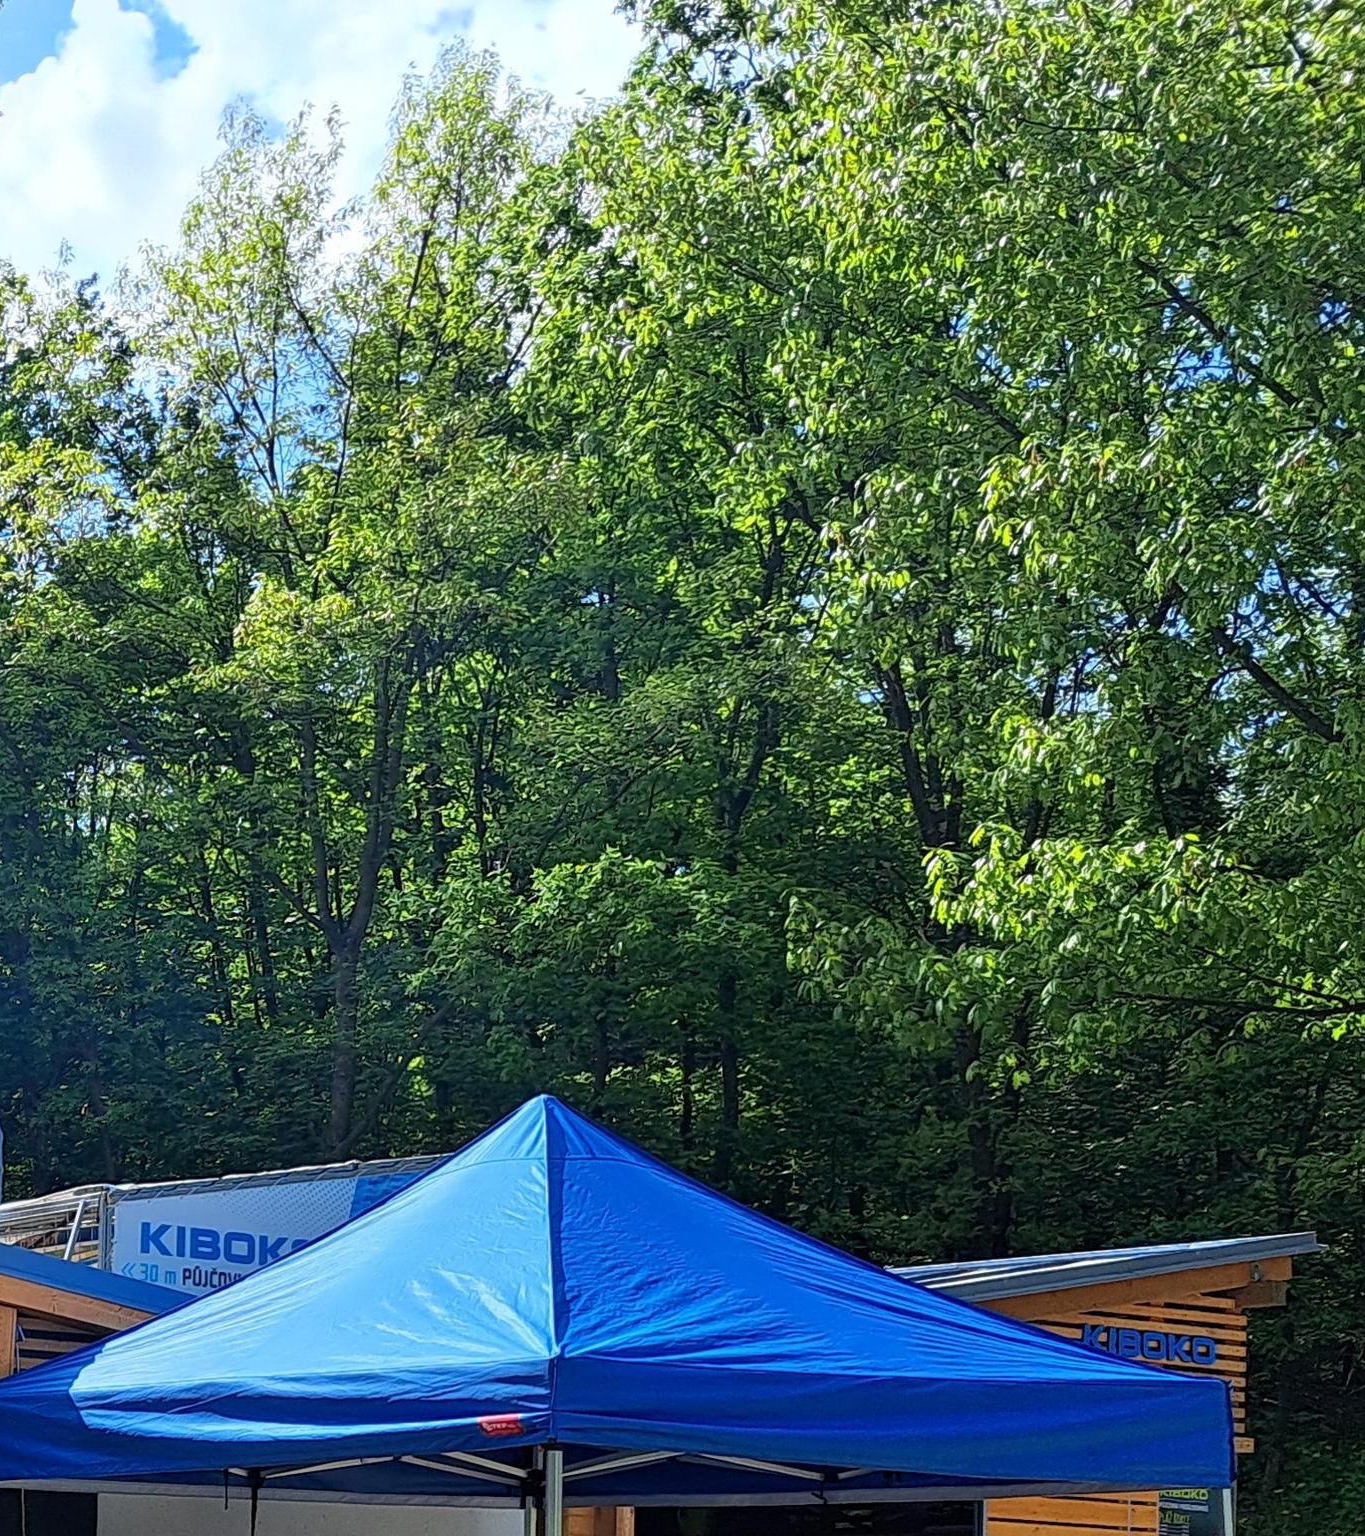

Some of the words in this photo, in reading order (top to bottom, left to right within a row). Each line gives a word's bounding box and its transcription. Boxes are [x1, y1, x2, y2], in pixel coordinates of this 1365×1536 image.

[140, 1263, 159, 1283] 30
[164, 1269, 177, 1285] m
[1083, 1322, 1217, 1365] KIBOKO
